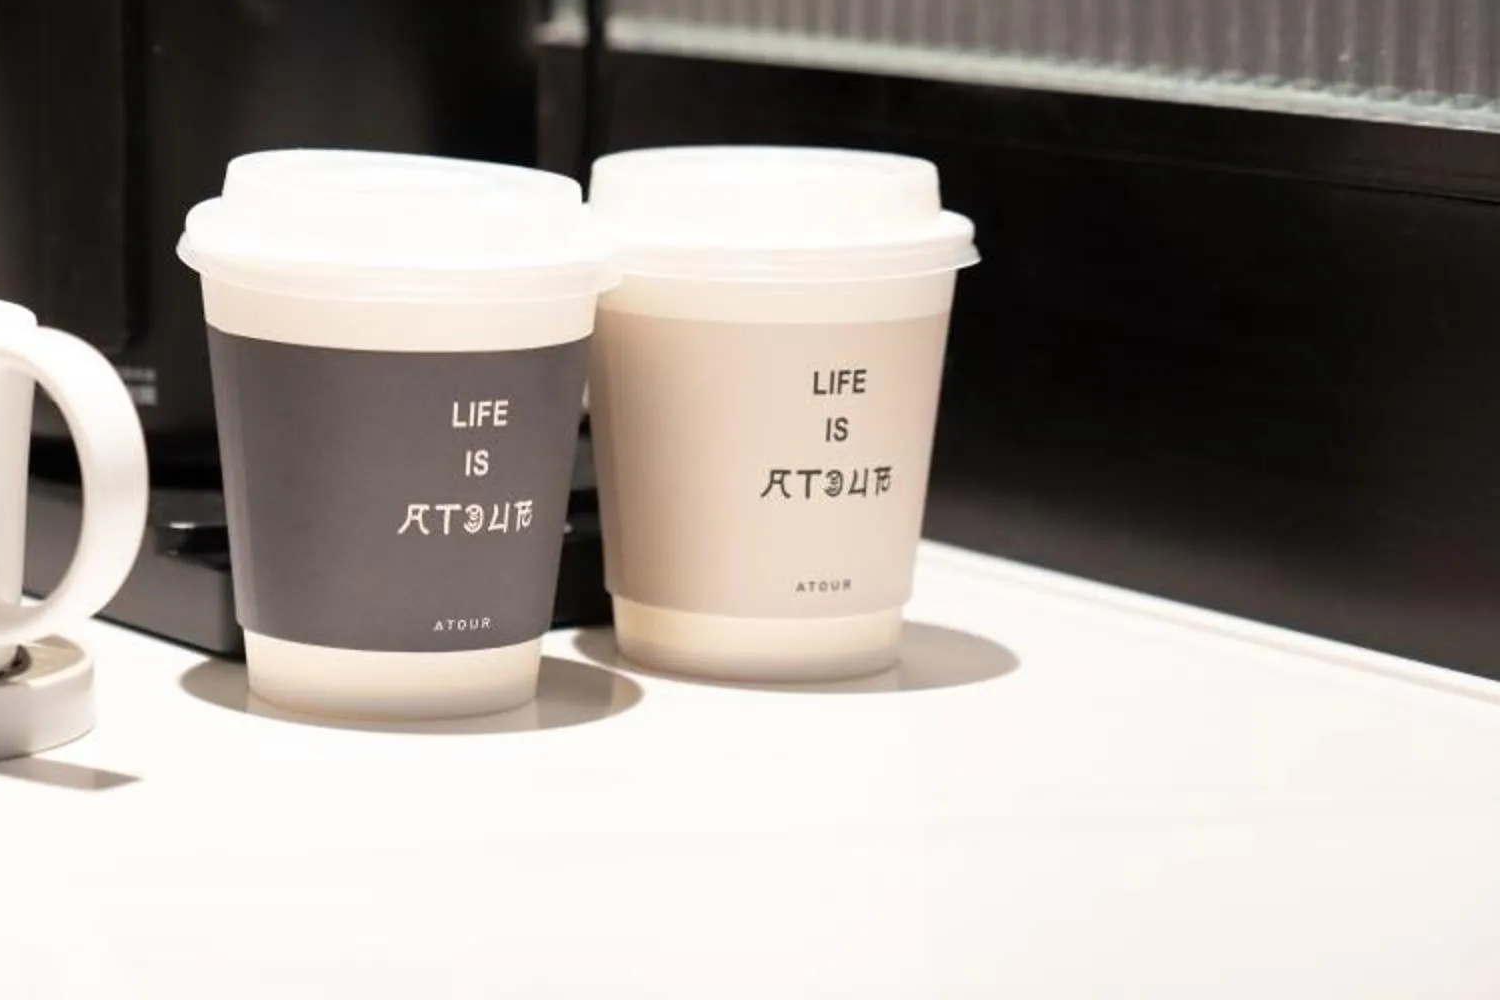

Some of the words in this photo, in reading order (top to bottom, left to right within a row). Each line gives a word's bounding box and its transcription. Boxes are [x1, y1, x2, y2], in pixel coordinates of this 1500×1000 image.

[813, 369, 867, 396] LIFE
[452, 400, 509, 428] LIFE
[825, 416, 849, 442] IS
[465, 450, 490, 477] IS
[795, 580, 852, 593] ATOUR
[433, 617, 492, 632] ATOUR
